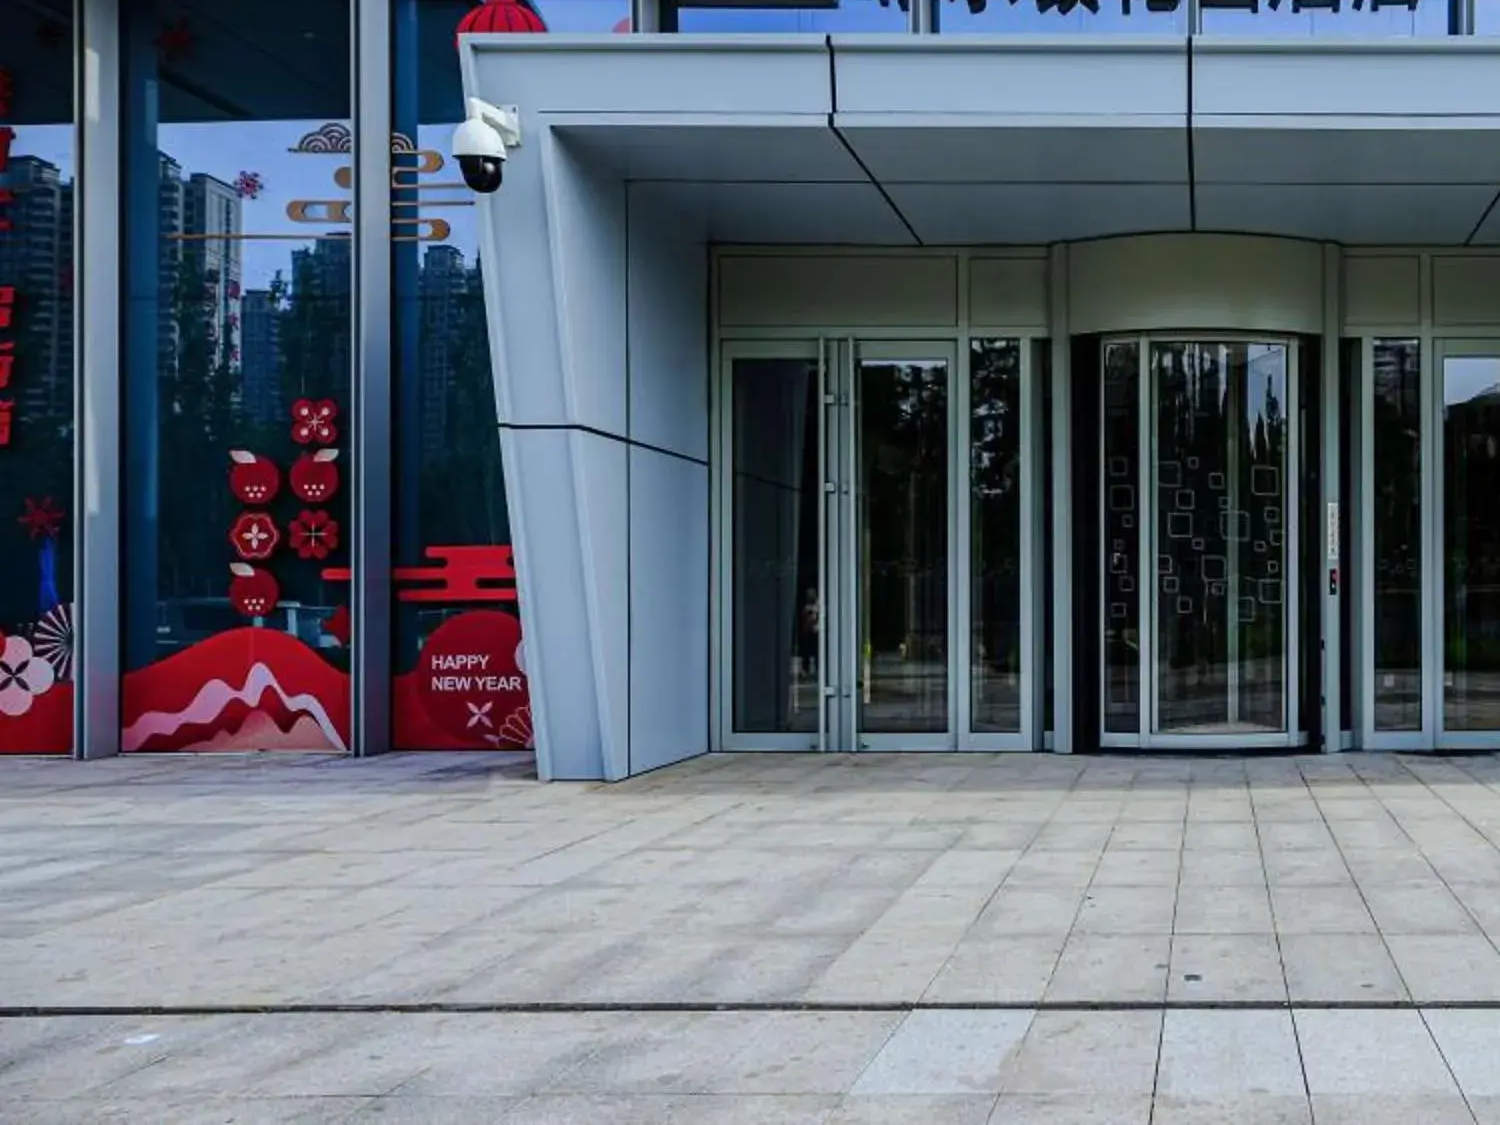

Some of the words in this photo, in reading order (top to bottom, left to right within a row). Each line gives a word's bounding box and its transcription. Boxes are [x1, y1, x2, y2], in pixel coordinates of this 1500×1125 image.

[431, 654, 489, 670] HAPPY
[431, 676, 471, 691] NEW
[474, 676, 522, 691] YEAR
